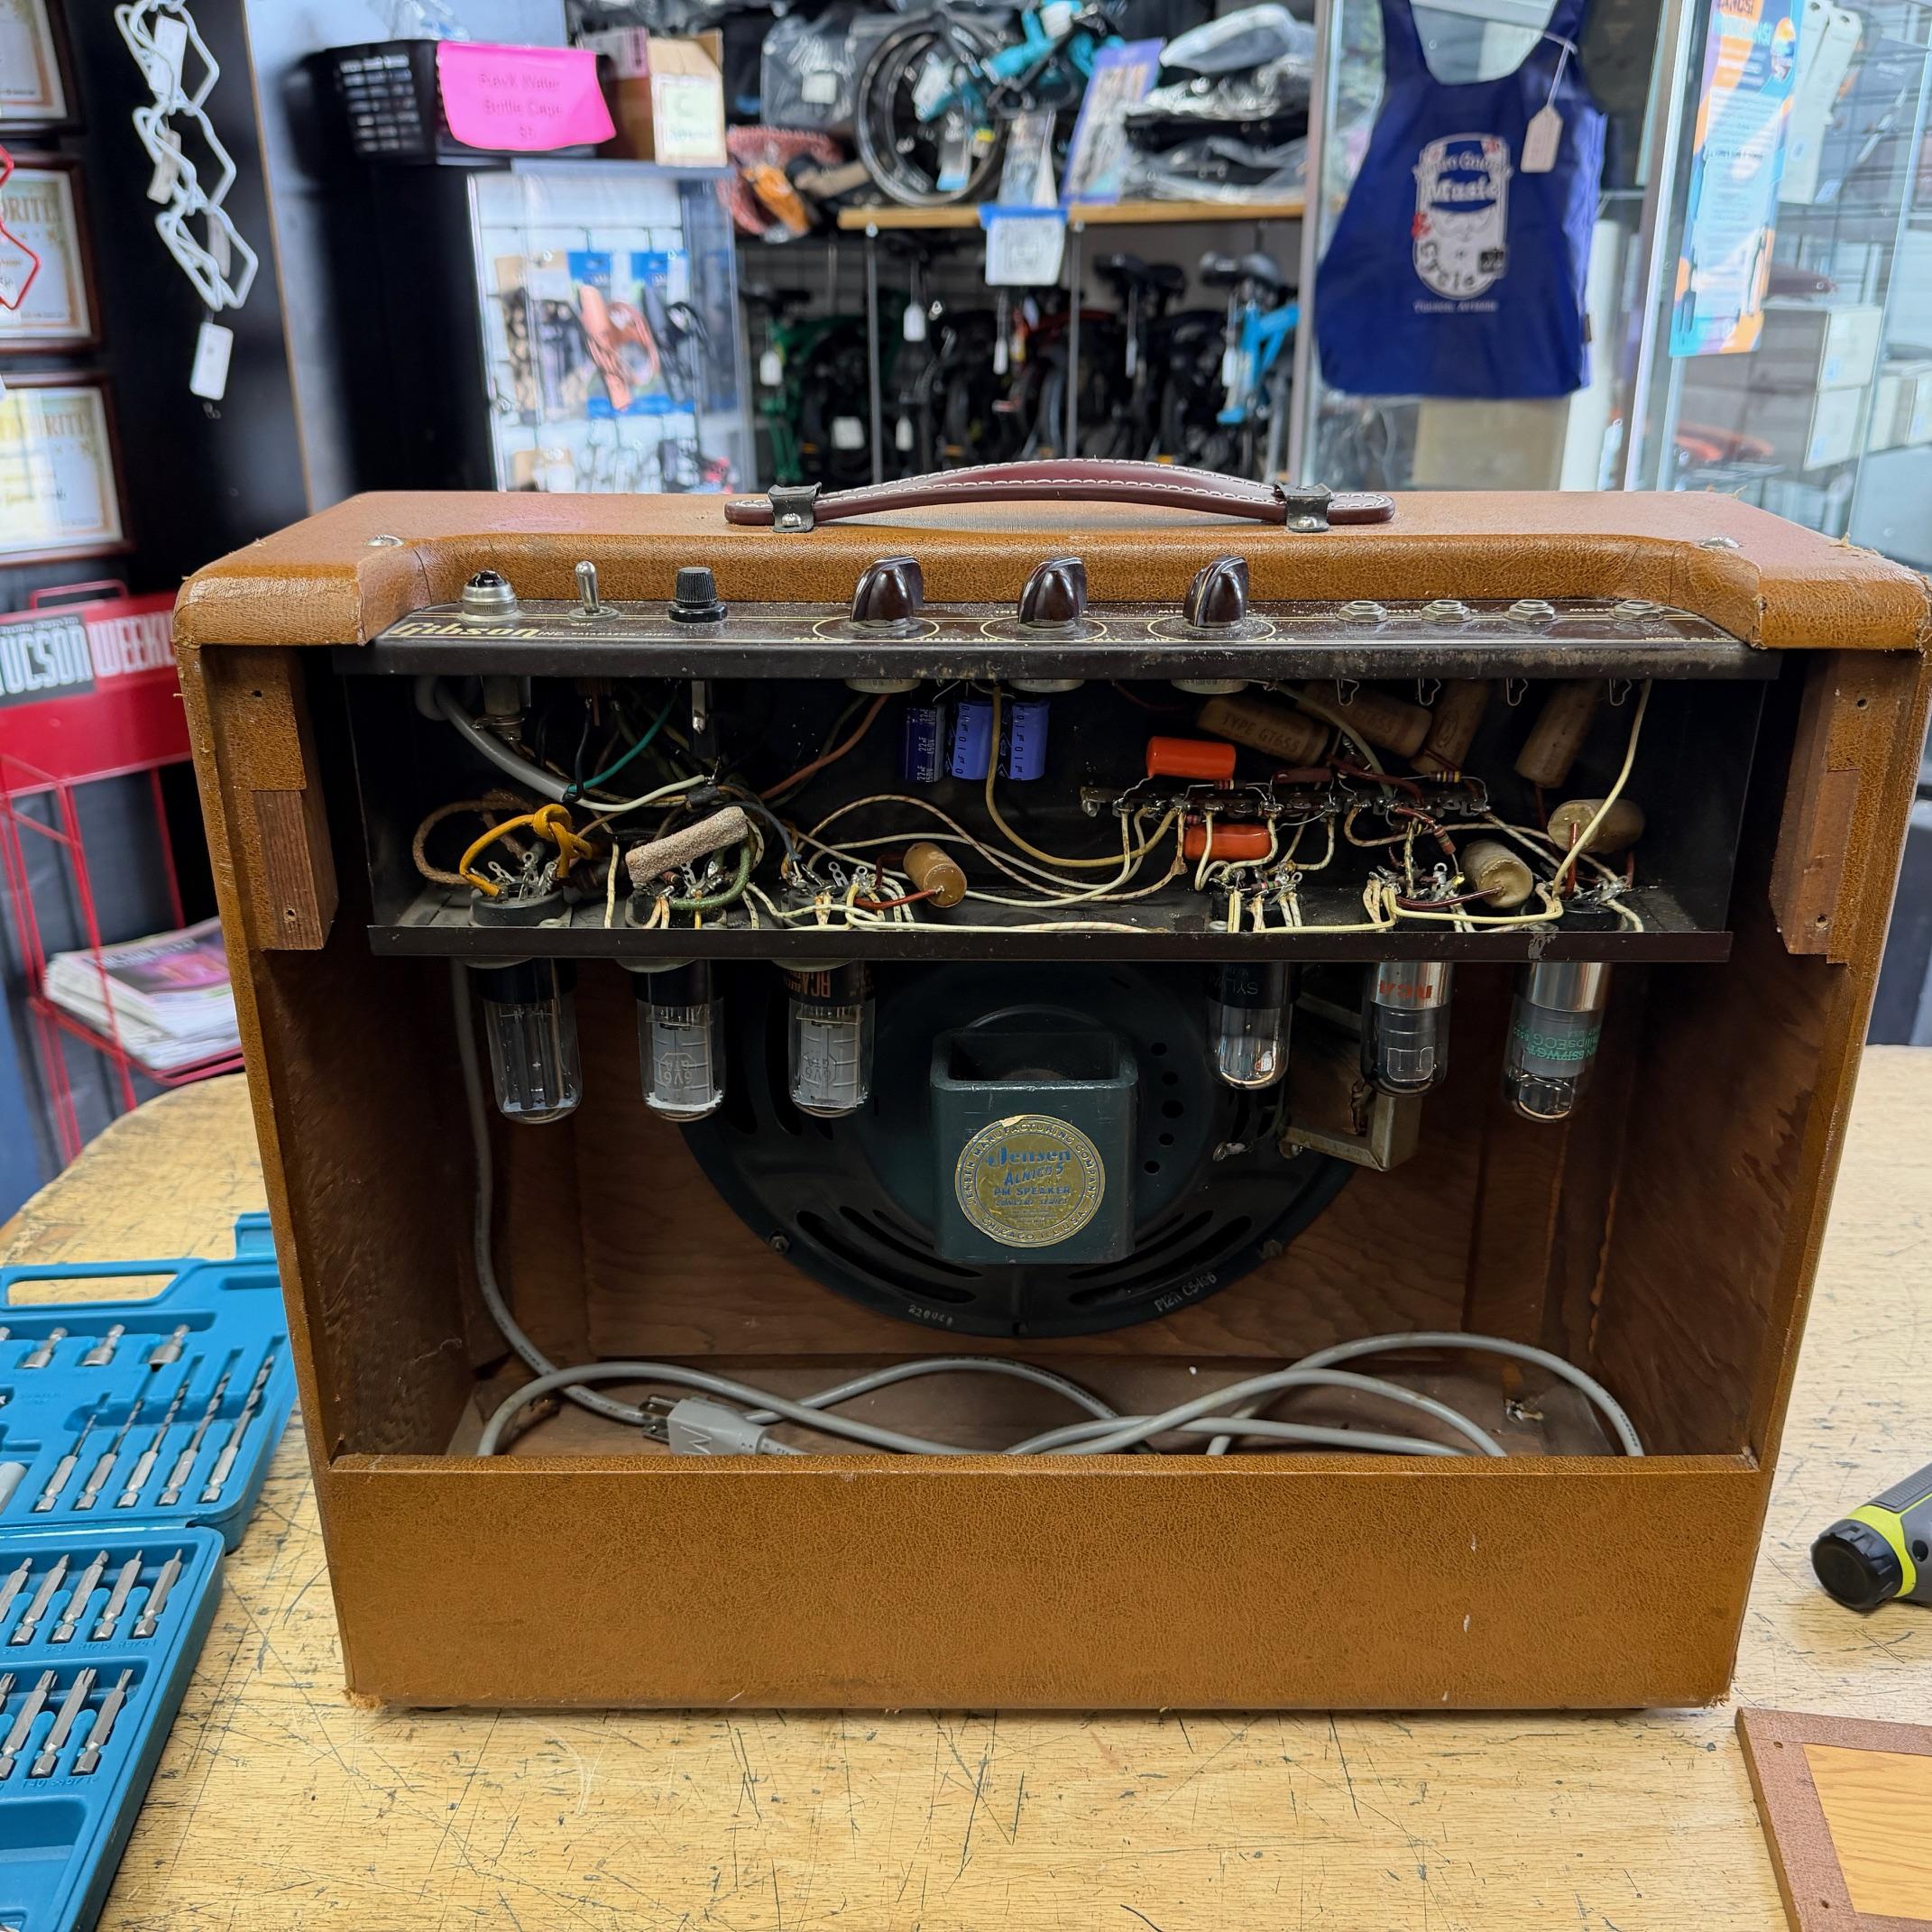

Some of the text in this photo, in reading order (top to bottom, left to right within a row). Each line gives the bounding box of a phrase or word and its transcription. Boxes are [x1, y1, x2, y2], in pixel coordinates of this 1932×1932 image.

[395, 622, 541, 638] Gibson
[0, 625, 94, 696] UCSON
[802, 971, 831, 998] RCA
[1379, 980, 1432, 998] RCA
[664, 1071, 694, 1084] 6V6
[963, 1124, 1097, 1205] JENSEN MANUFACTURING COMPANY
[986, 1146, 1072, 1168] Jensen
[994, 1186, 1071, 1196] PM SPEAKER
